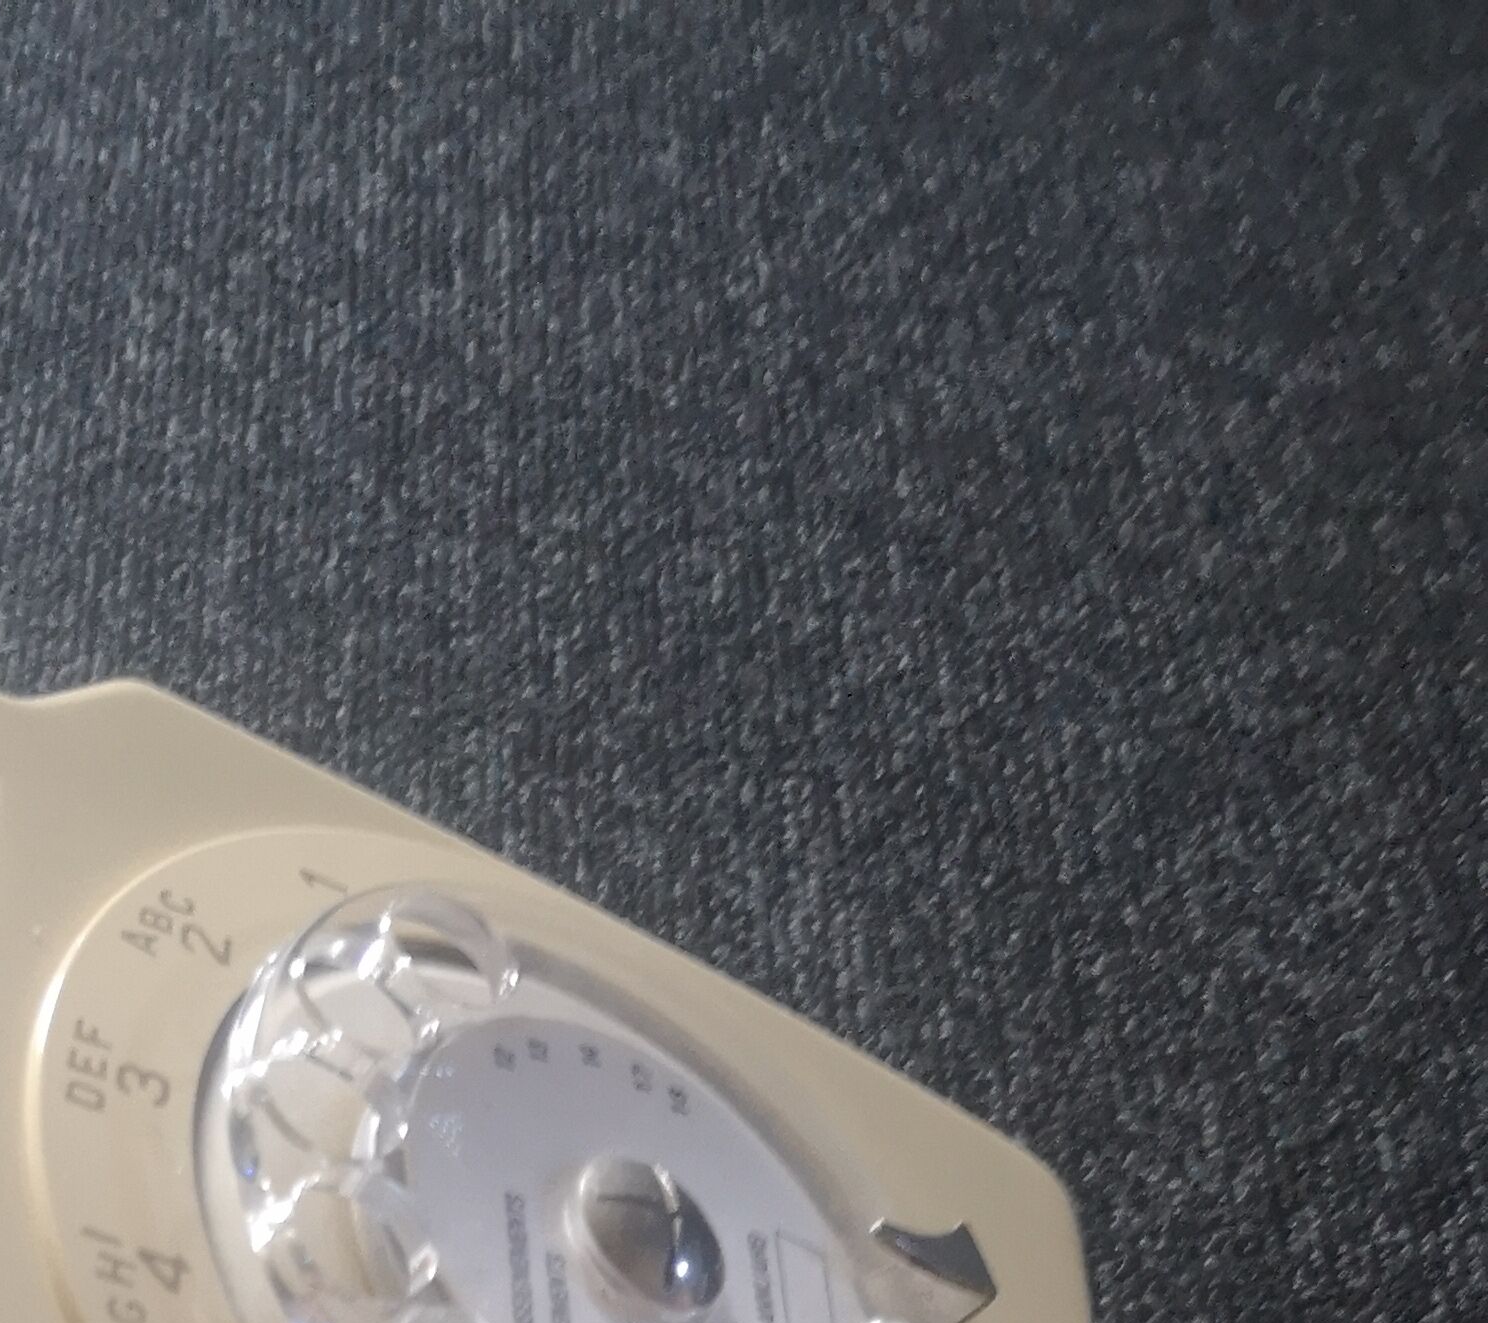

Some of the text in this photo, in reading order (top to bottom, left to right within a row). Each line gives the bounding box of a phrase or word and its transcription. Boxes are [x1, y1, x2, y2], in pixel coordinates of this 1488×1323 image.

[119, 888, 198, 957] ABC
[178, 918, 233, 967] 2
[64, 1017, 116, 1113] DEF
[115, 1061, 170, 1109] 3
[139, 1249, 191, 1296] 4
